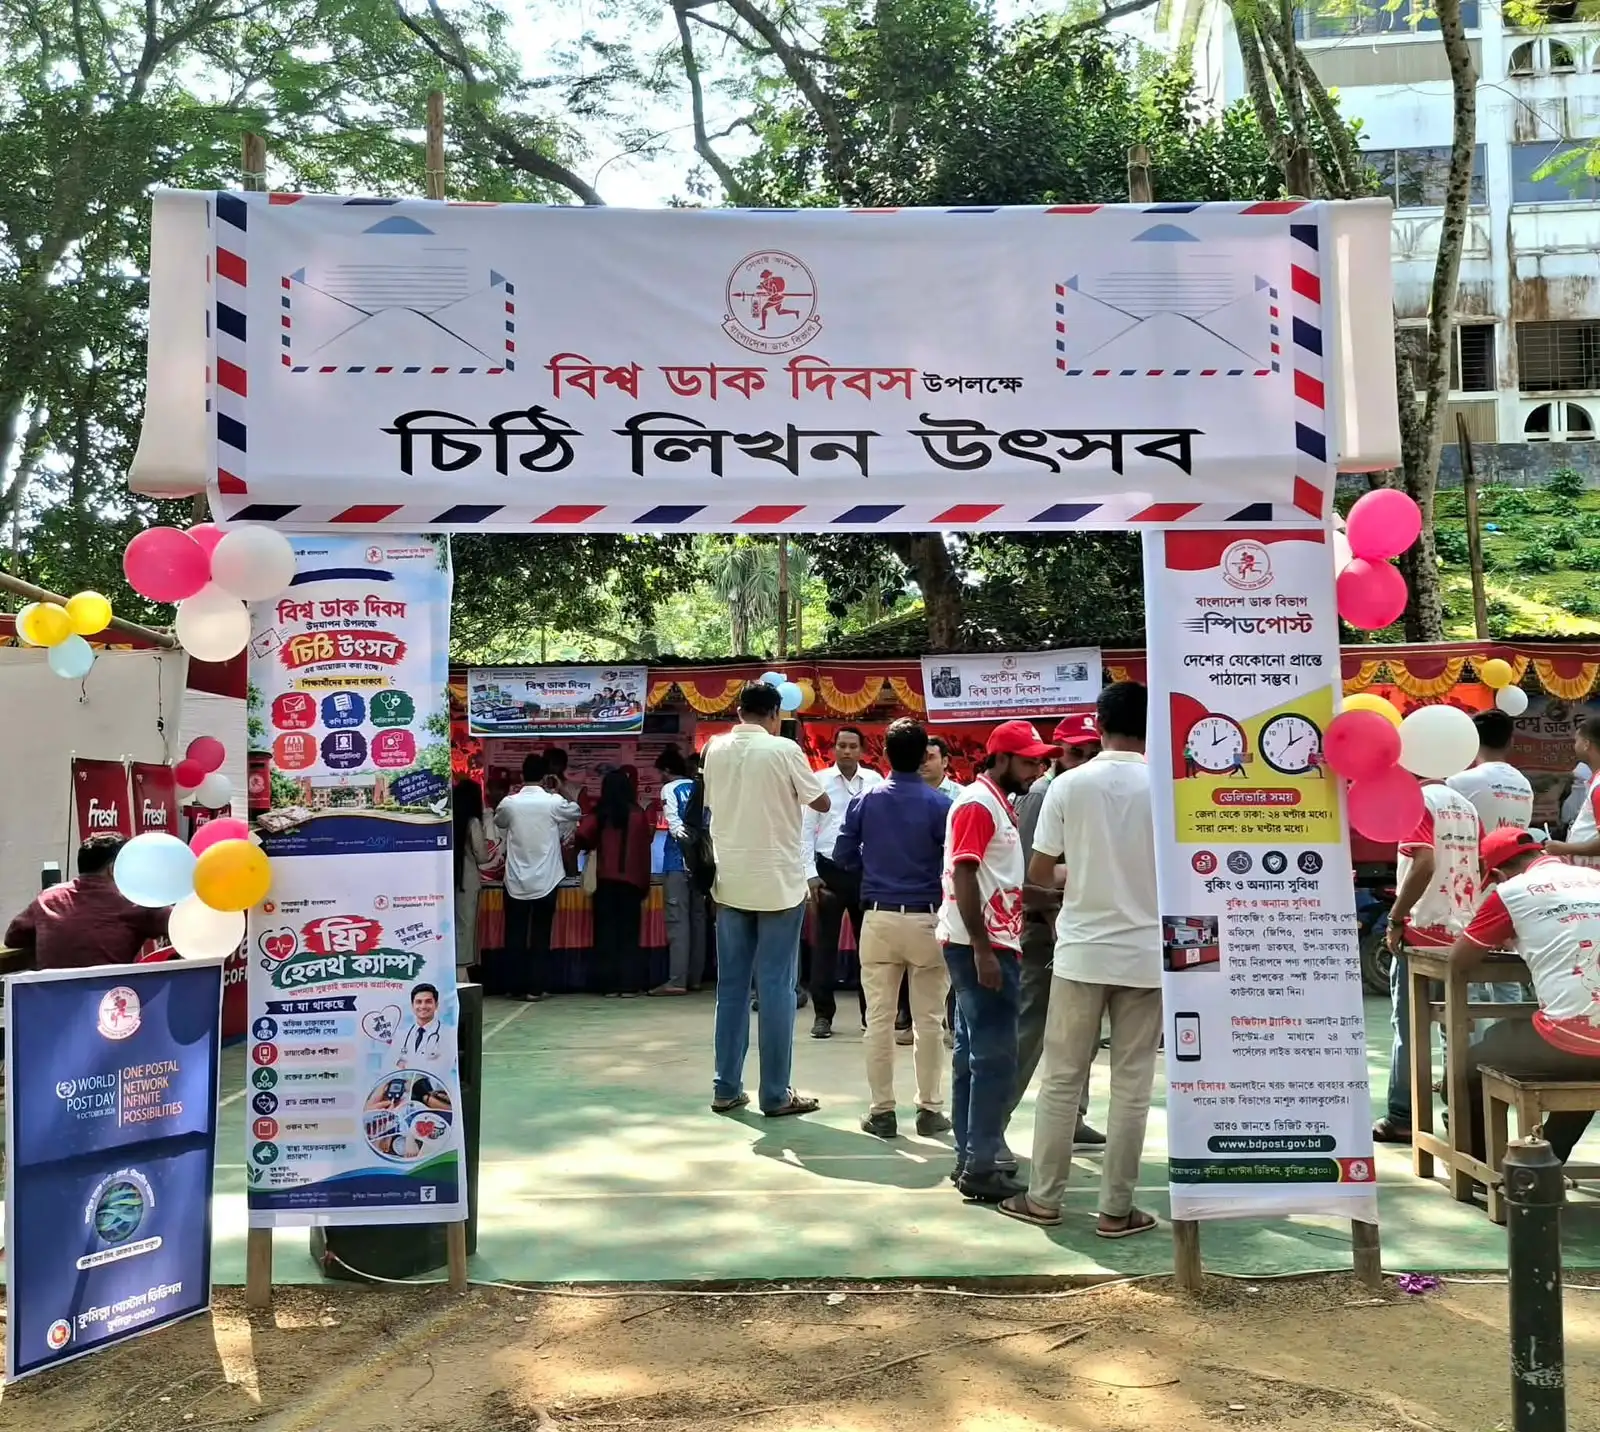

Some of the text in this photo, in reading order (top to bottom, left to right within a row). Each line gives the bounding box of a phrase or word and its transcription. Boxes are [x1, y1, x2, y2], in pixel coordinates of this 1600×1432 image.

[730, 324, 816, 350] বাংলাদেশ ডাক বিভাগ
[544, 353, 1025, 400] বিশ্ব ডাক দিবস উপলক্ষে
[380, 405, 1206, 478] চিঠি লিখন উৎসব
[1195, 594, 1308, 607] বাংলাদেশ ডাক বিভাগ
[276, 595, 407, 624] বিশ্ব ডাক দিবস
[343, 619, 377, 628] উপলক্ষে
[1203, 612, 1314, 634] স্পিডপোস্ট
[289, 633, 399, 665] চিঠি উৎসব
[1184, 654, 1323, 667] দেশের যেকোনো প্রান্তে
[301, 677, 343, 688] শিক্ষার্থীদের
[980, 671, 1041, 684] অপ্রতীম স্টল
[1209, 669, 1256, 686] পাঠানো
[526, 680, 590, 691] বিশ্ব ডাক দিবস
[968, 684, 1041, 697] বিশ্ব ডাক দিবস
[598, 707, 630, 718] Gen Z
[1543, 722, 1572, 733] ডাক
[1219, 790, 1293, 802] ডেলিভারি সময়
[88, 798, 117, 828] Fresh
[143, 798, 167, 826] Fresh
[1195, 811, 1217, 819] জেলা
[1219, 810, 1240, 819] থেকে
[1243, 811, 1265, 819] ঢাকা:
[1268, 811, 1280, 819] ২৪
[1195, 825, 1214, 833] সারা
[1217, 825, 1237, 833] দেশ:
[1241, 825, 1254, 833] ৪৮
[1204, 878, 1319, 893] বুকিং ও অন্যান্য সুবিধা
[1526, 883, 1556, 897] বিশ্ব
[1226, 899, 1248, 911] বুকিং
[1261, 900, 1290, 908] অন্যান্য
[1227, 912, 1264, 923] প্যাকেজিং
[314, 917, 372, 952] ফ্রি
[1227, 929, 1255, 938] অফিসে
[1304, 929, 1324, 937] প্রধান
[1228, 943, 1260, 953] উপজেলা
[1250, 957, 1282, 968] নিরাপদে
[1303, 956, 1340, 967] প্যাকেজিং
[281, 953, 416, 985] হেলথ ক্যাম্প
[1229, 973, 1246, 982] এবং
[1252, 973, 1284, 982] প্রাপকের
[1313, 972, 1339, 982] ঠিকানা
[289, 987, 314, 996] আপনার
[341, 982, 368, 991] আমাদের
[1230, 986, 1265, 997] কাউন্টারে
[1268, 988, 1284, 997] জমা
[281, 1000, 345, 1012] যা যা থাকছে
[1231, 1016, 1338, 1027] ডিজিটাল অনলাইন
[1288, 1032, 1315, 1041] মাধ্যমে
[1327, 1033, 1338, 1041] ২৪
[318, 1048, 338, 1056] পরীক্ষা
[1233, 1047, 1267, 1057] পার্সেলের
[1324, 1047, 1342, 1056] জানা
[123, 1060, 179, 1080] ONE POSTAL
[319, 1072, 339, 1080] পরীক্ষা
[78, 1074, 116, 1092] WORLD
[123, 1076, 169, 1094] NETWORK
[1228, 1080, 1266, 1090] অনলাইনে
[1288, 1081, 1314, 1089] জানতে
[1317, 1081, 1344, 1090] ব্যবহার
[66, 1092, 115, 1113] POST DAY
[123, 1091, 161, 1108] INFINITE
[1193, 1096, 1217, 1105] পারেন
[1219, 1096, 1236, 1105] ডাক
[1238, 1094, 1271, 1105] বিভাগের
[1274, 1095, 1296, 1108] মাশুল
[81, 1109, 104, 1119] OCTOBER
[123, 1101, 183, 1124] POSSIBILITIES
[1214, 1122, 1238, 1131] আরও
[1241, 1122, 1270, 1131] জানতে
[1273, 1119, 1301, 1131] ভিজিট
[1218, 1138, 1321, 1150] www.bdpost.gov.bd
[78, 1281, 182, 1329] কুমিল্লা পোস্টাল ডিভিশন
